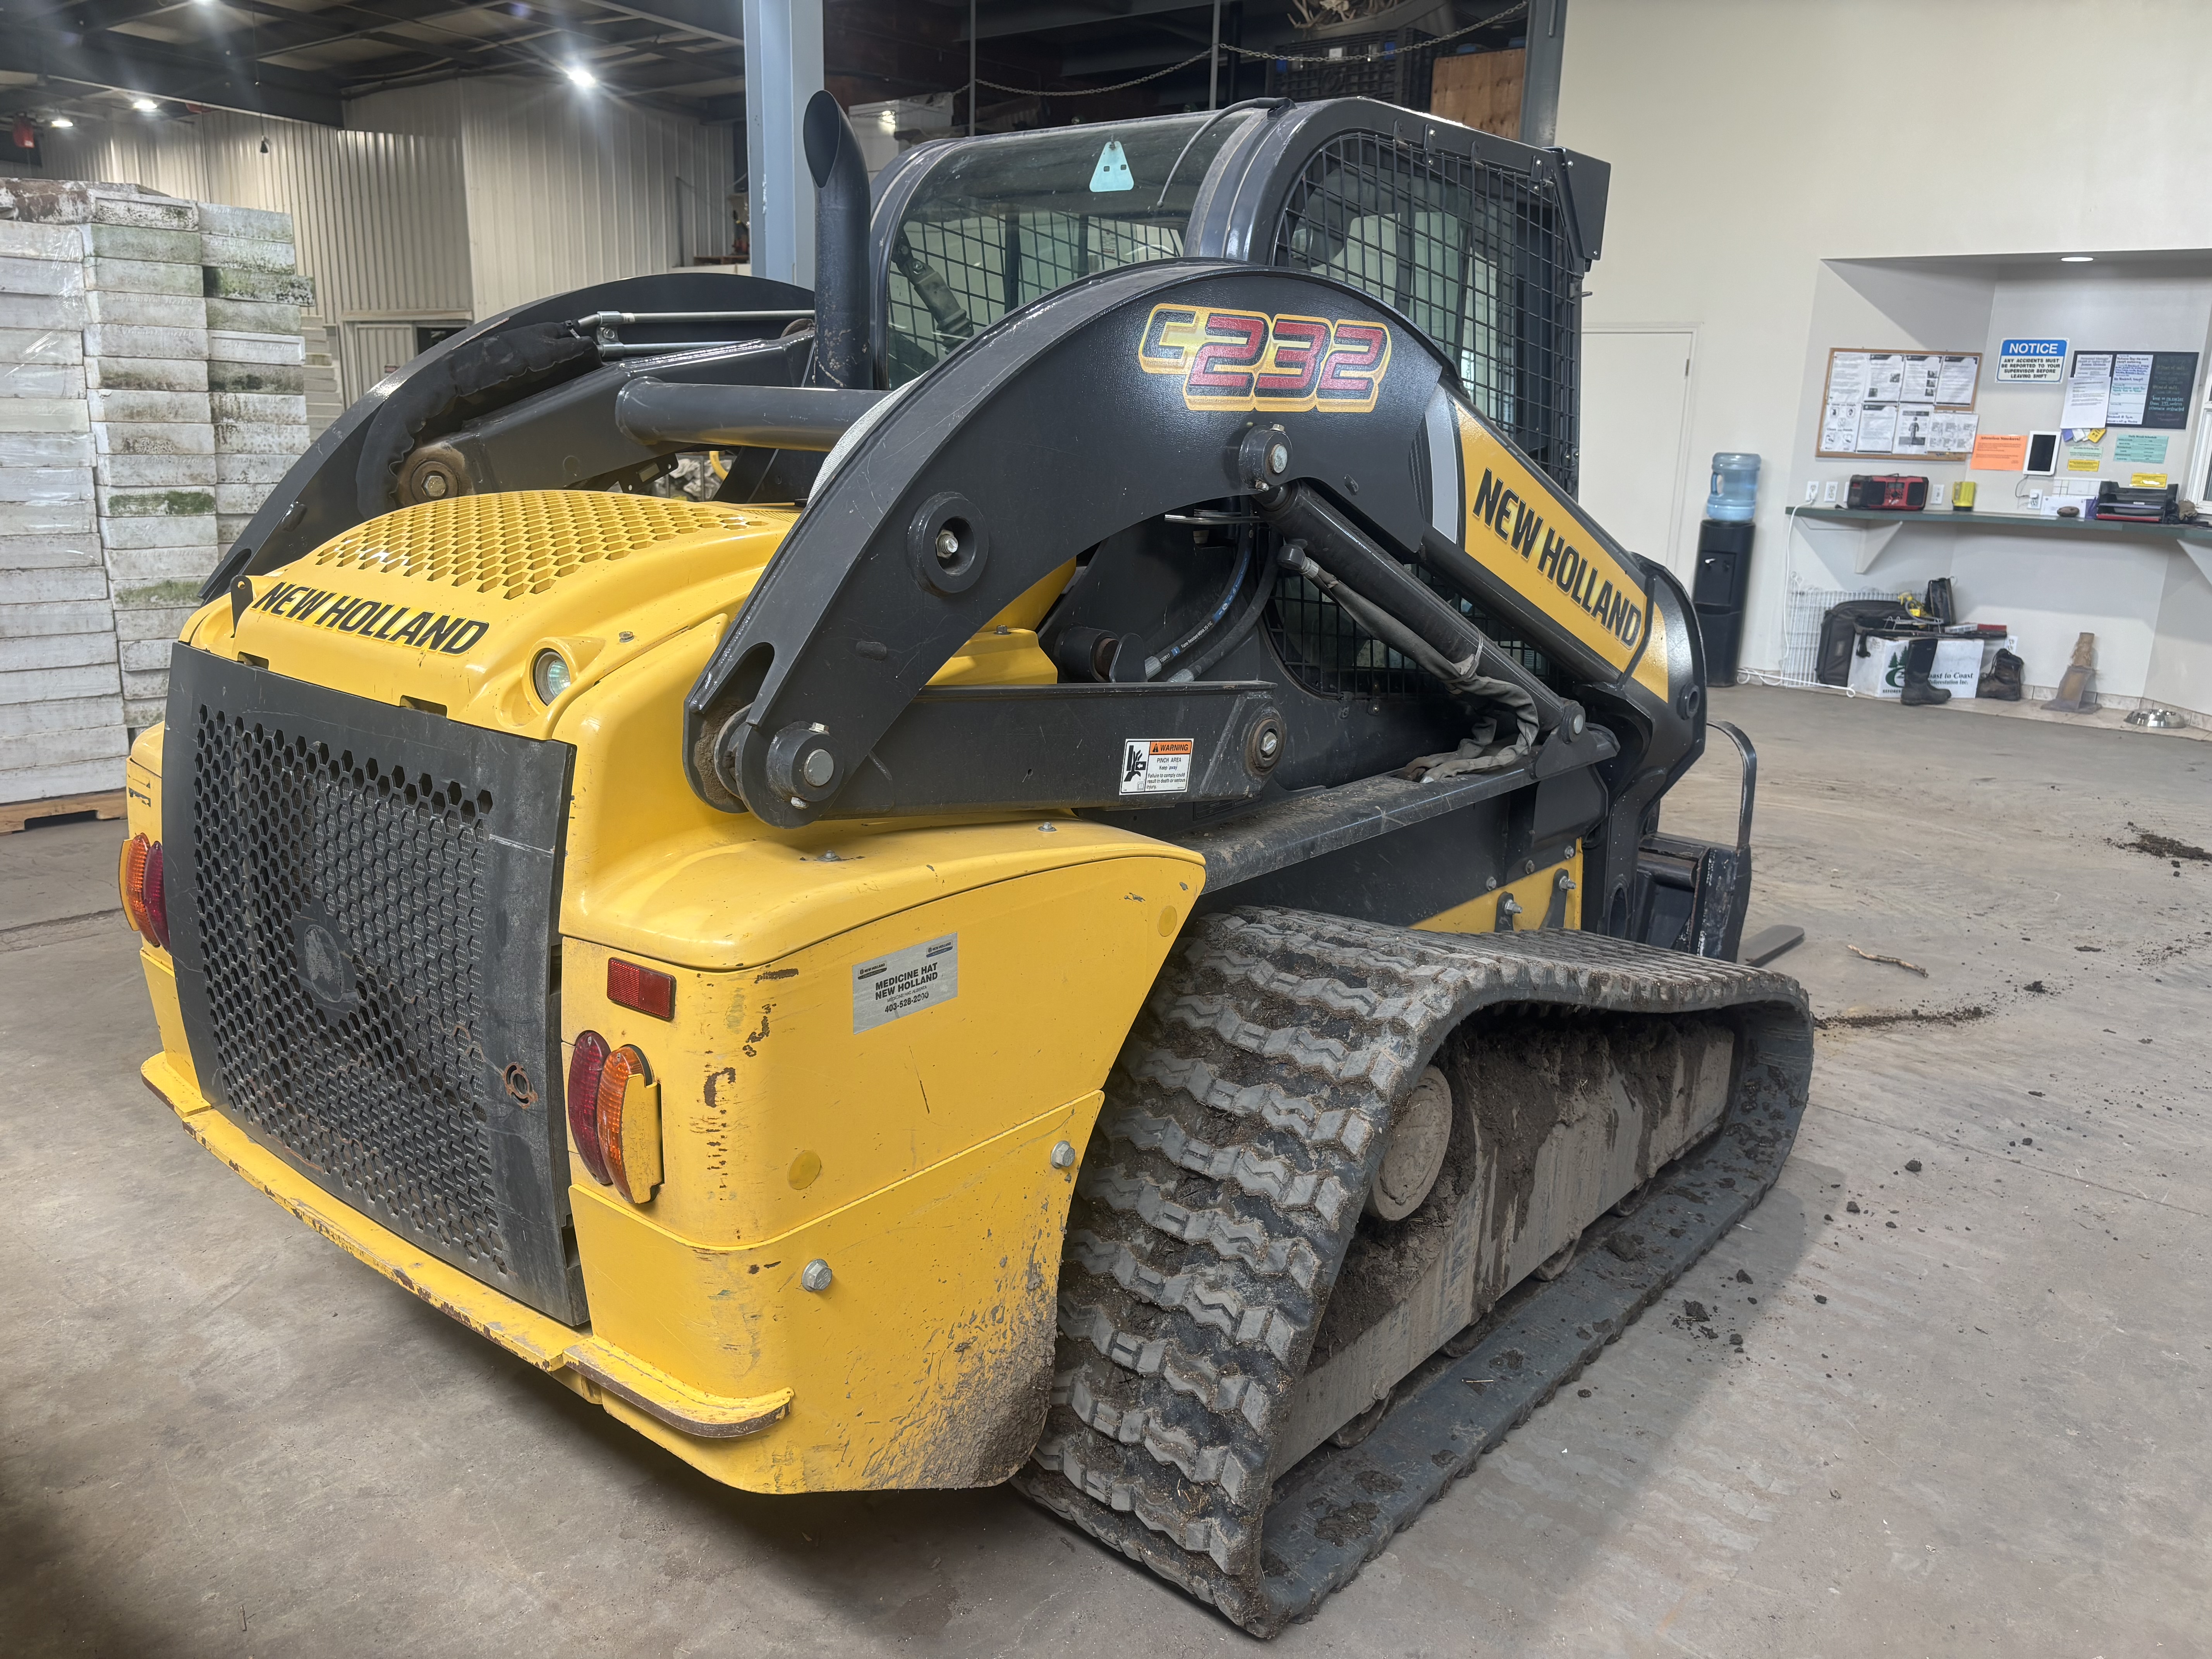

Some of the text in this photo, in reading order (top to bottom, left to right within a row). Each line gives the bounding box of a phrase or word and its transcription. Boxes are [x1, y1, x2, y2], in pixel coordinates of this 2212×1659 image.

[1139, 303, 1391, 412] C232
[2009, 343, 2058, 354] NOTICE
[1473, 467, 1642, 649] NEW HOLLAND
[252, 581, 489, 654] NEW HOLLAND
[875, 986, 895, 1000] NEW
[898, 972, 938, 992] HOLLAND
[876, 969, 919, 991] MEDICINE
[921, 962, 938, 975] HAT
[887, 993, 904, 1003] MEDICINE
[912, 985, 927, 994] ALBERTA
